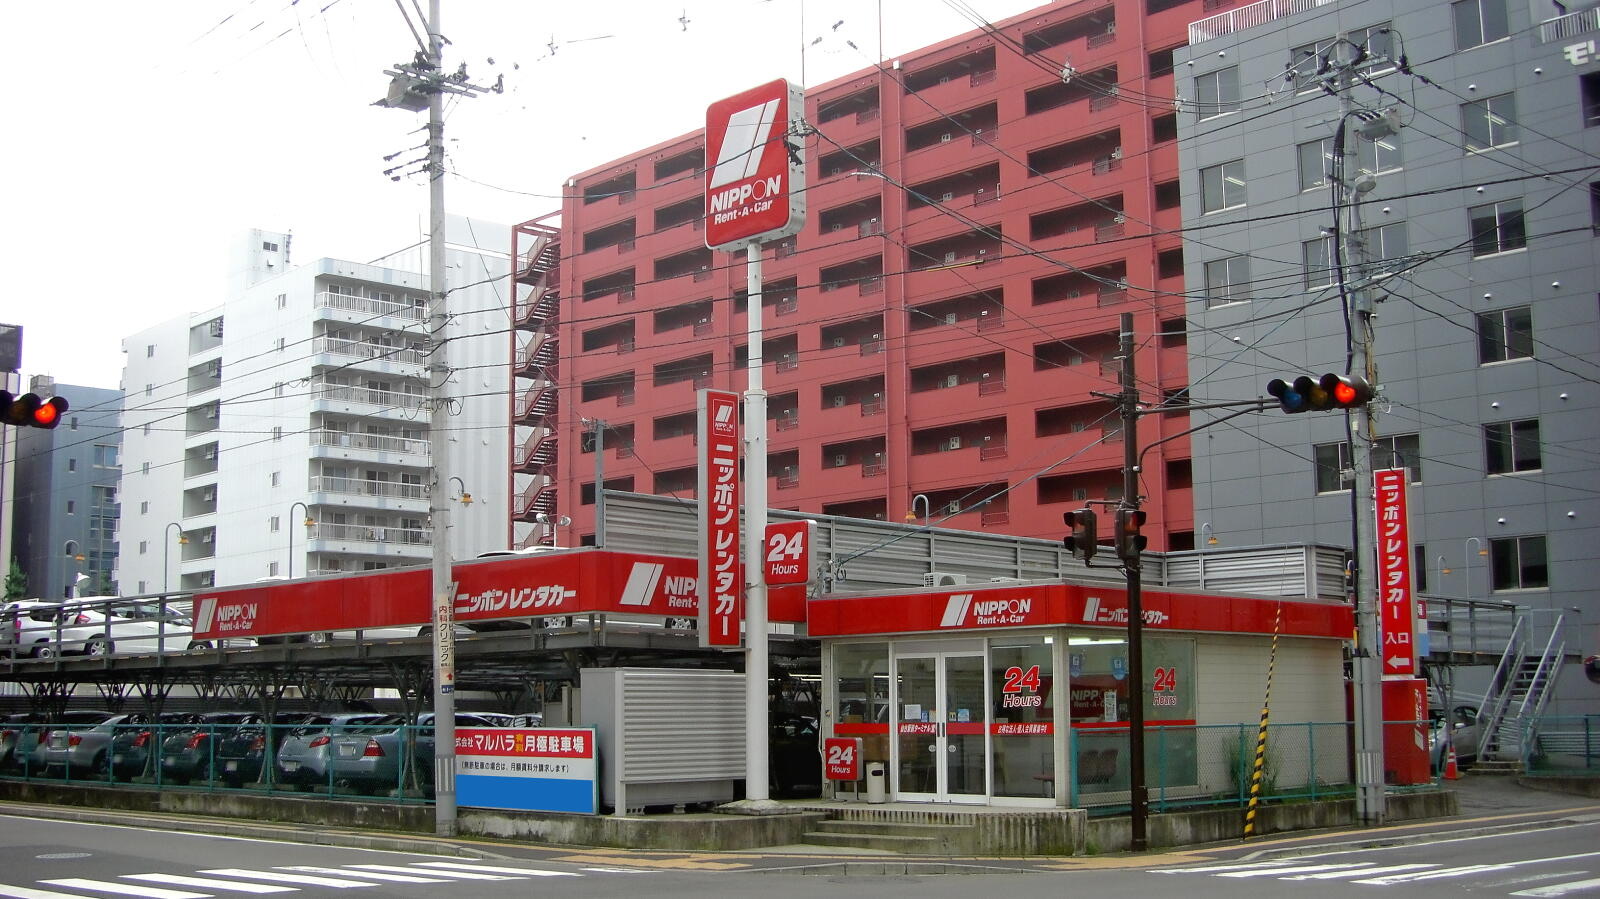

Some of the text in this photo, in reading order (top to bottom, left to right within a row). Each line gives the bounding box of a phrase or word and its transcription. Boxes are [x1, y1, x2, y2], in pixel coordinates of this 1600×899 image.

[710, 174, 782, 214] NIPPON
[713, 444, 736, 636] ニッポンレンタカー
[767, 531, 804, 562] 24
[1381, 475, 1404, 619] ニッポンレンタカー
[771, 563, 799, 575] Hours
[664, 576, 698, 596] NIP
[454, 584, 577, 614] ニッポンレンタカー
[973, 599, 1031, 616] NIPPON
[217, 603, 258, 621] NIPPON
[439, 605, 449, 662] 内科クリニック
[1385, 632, 1409, 644] 入口
[1003, 665, 1041, 693] 24
[1153, 667, 1177, 692] 24
[1003, 694, 1042, 708] Hours
[1153, 693, 1177, 706] Hours
[828, 745, 854, 765] 24
[831, 765, 851, 774] Hours
